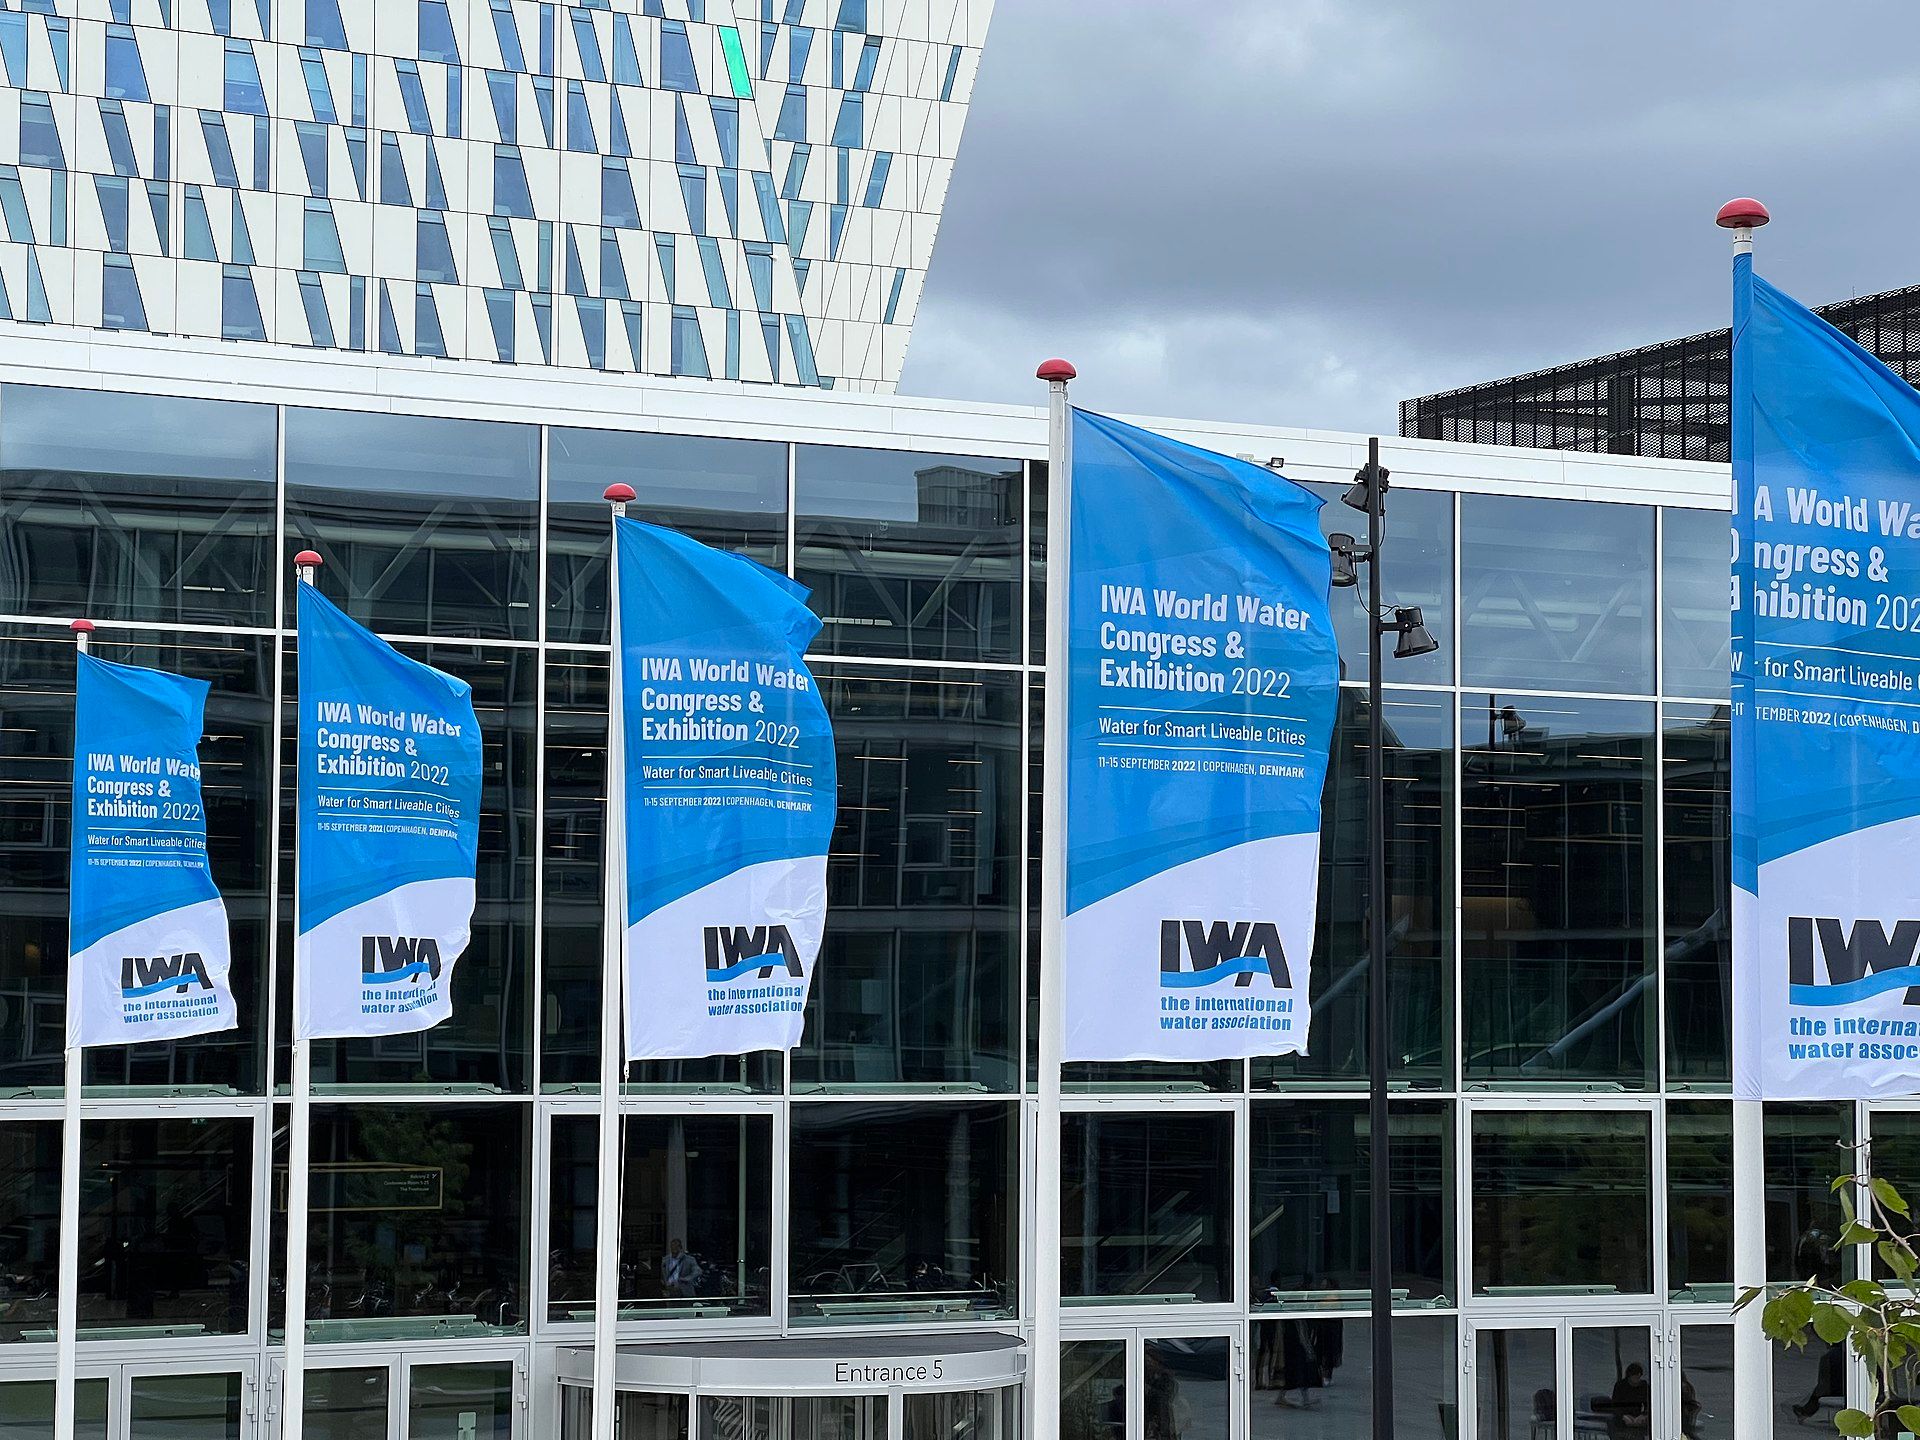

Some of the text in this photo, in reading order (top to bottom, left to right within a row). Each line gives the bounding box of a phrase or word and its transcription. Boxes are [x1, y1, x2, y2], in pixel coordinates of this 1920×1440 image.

[1787, 487, 1869, 533] World
[1867, 546, 1889, 583] &
[1102, 585, 1311, 631] IWA World Water
[1101, 622, 1245, 661] Congress &
[642, 658, 809, 692] IWA World Water
[1101, 659, 1291, 699] Exhibition 2022
[1765, 657, 1789, 678] for
[1794, 660, 1846, 684] Smart
[1850, 665, 1913, 691] Liveable
[642, 688, 765, 717] Congress &
[318, 702, 461, 737] IWA World Water
[1802, 711, 1831, 726] 2022
[1840, 714, 1910, 735] COPENHAGEN,
[318, 728, 418, 757] Congress &
[642, 717, 800, 749] Exhibition 2022
[1099, 718, 1305, 746] Water for Smart Liveable Cities
[88, 753, 201, 782] IWA World Wate
[318, 754, 450, 786] Exhibition 2022
[643, 765, 813, 787] Water for Smart Liveable Cities
[1099, 757, 1118, 768] 11-15
[1121, 758, 1170, 771] SEPTEMBER
[1172, 760, 1196, 772] 2022
[1203, 761, 1257, 776] COPENHAGEN,
[1260, 764, 1305, 779] DENMARK
[88, 776, 171, 799] Congress &
[88, 799, 200, 821] Exhibition 2022
[318, 795, 460, 819] Water for Smart Liveable Cities
[644, 798, 658, 807] 11-15
[660, 797, 703, 807] SEPTEMBER
[703, 797, 721, 806] 2022
[726, 797, 776, 809] COPENHAGEN,
[777, 801, 812, 812] DENMARK
[331, 823, 368, 832] SEPTEMBER
[369, 825, 383, 833] 2022
[88, 835, 206, 850] Water for Smart Liveable Cities
[362, 937, 441, 983] IWA
[704, 925, 804, 981] IWA
[1161, 920, 1293, 989] IWA
[1789, 917, 1920, 1005] IW
[121, 953, 215, 997] IWA
[124, 994, 217, 1012] the international
[363, 990, 381, 1000] the
[708, 985, 804, 1001] the international
[1161, 996, 1293, 1013] the international
[124, 1007, 219, 1023] water association
[362, 1004, 396, 1013] water
[708, 1000, 803, 1016] water association
[1160, 1015, 1291, 1030] water association
[1790, 1017, 1920, 1037] the interna
[1789, 1043, 1918, 1060] water assoc
[835, 1360, 943, 1382] Entrance 5
